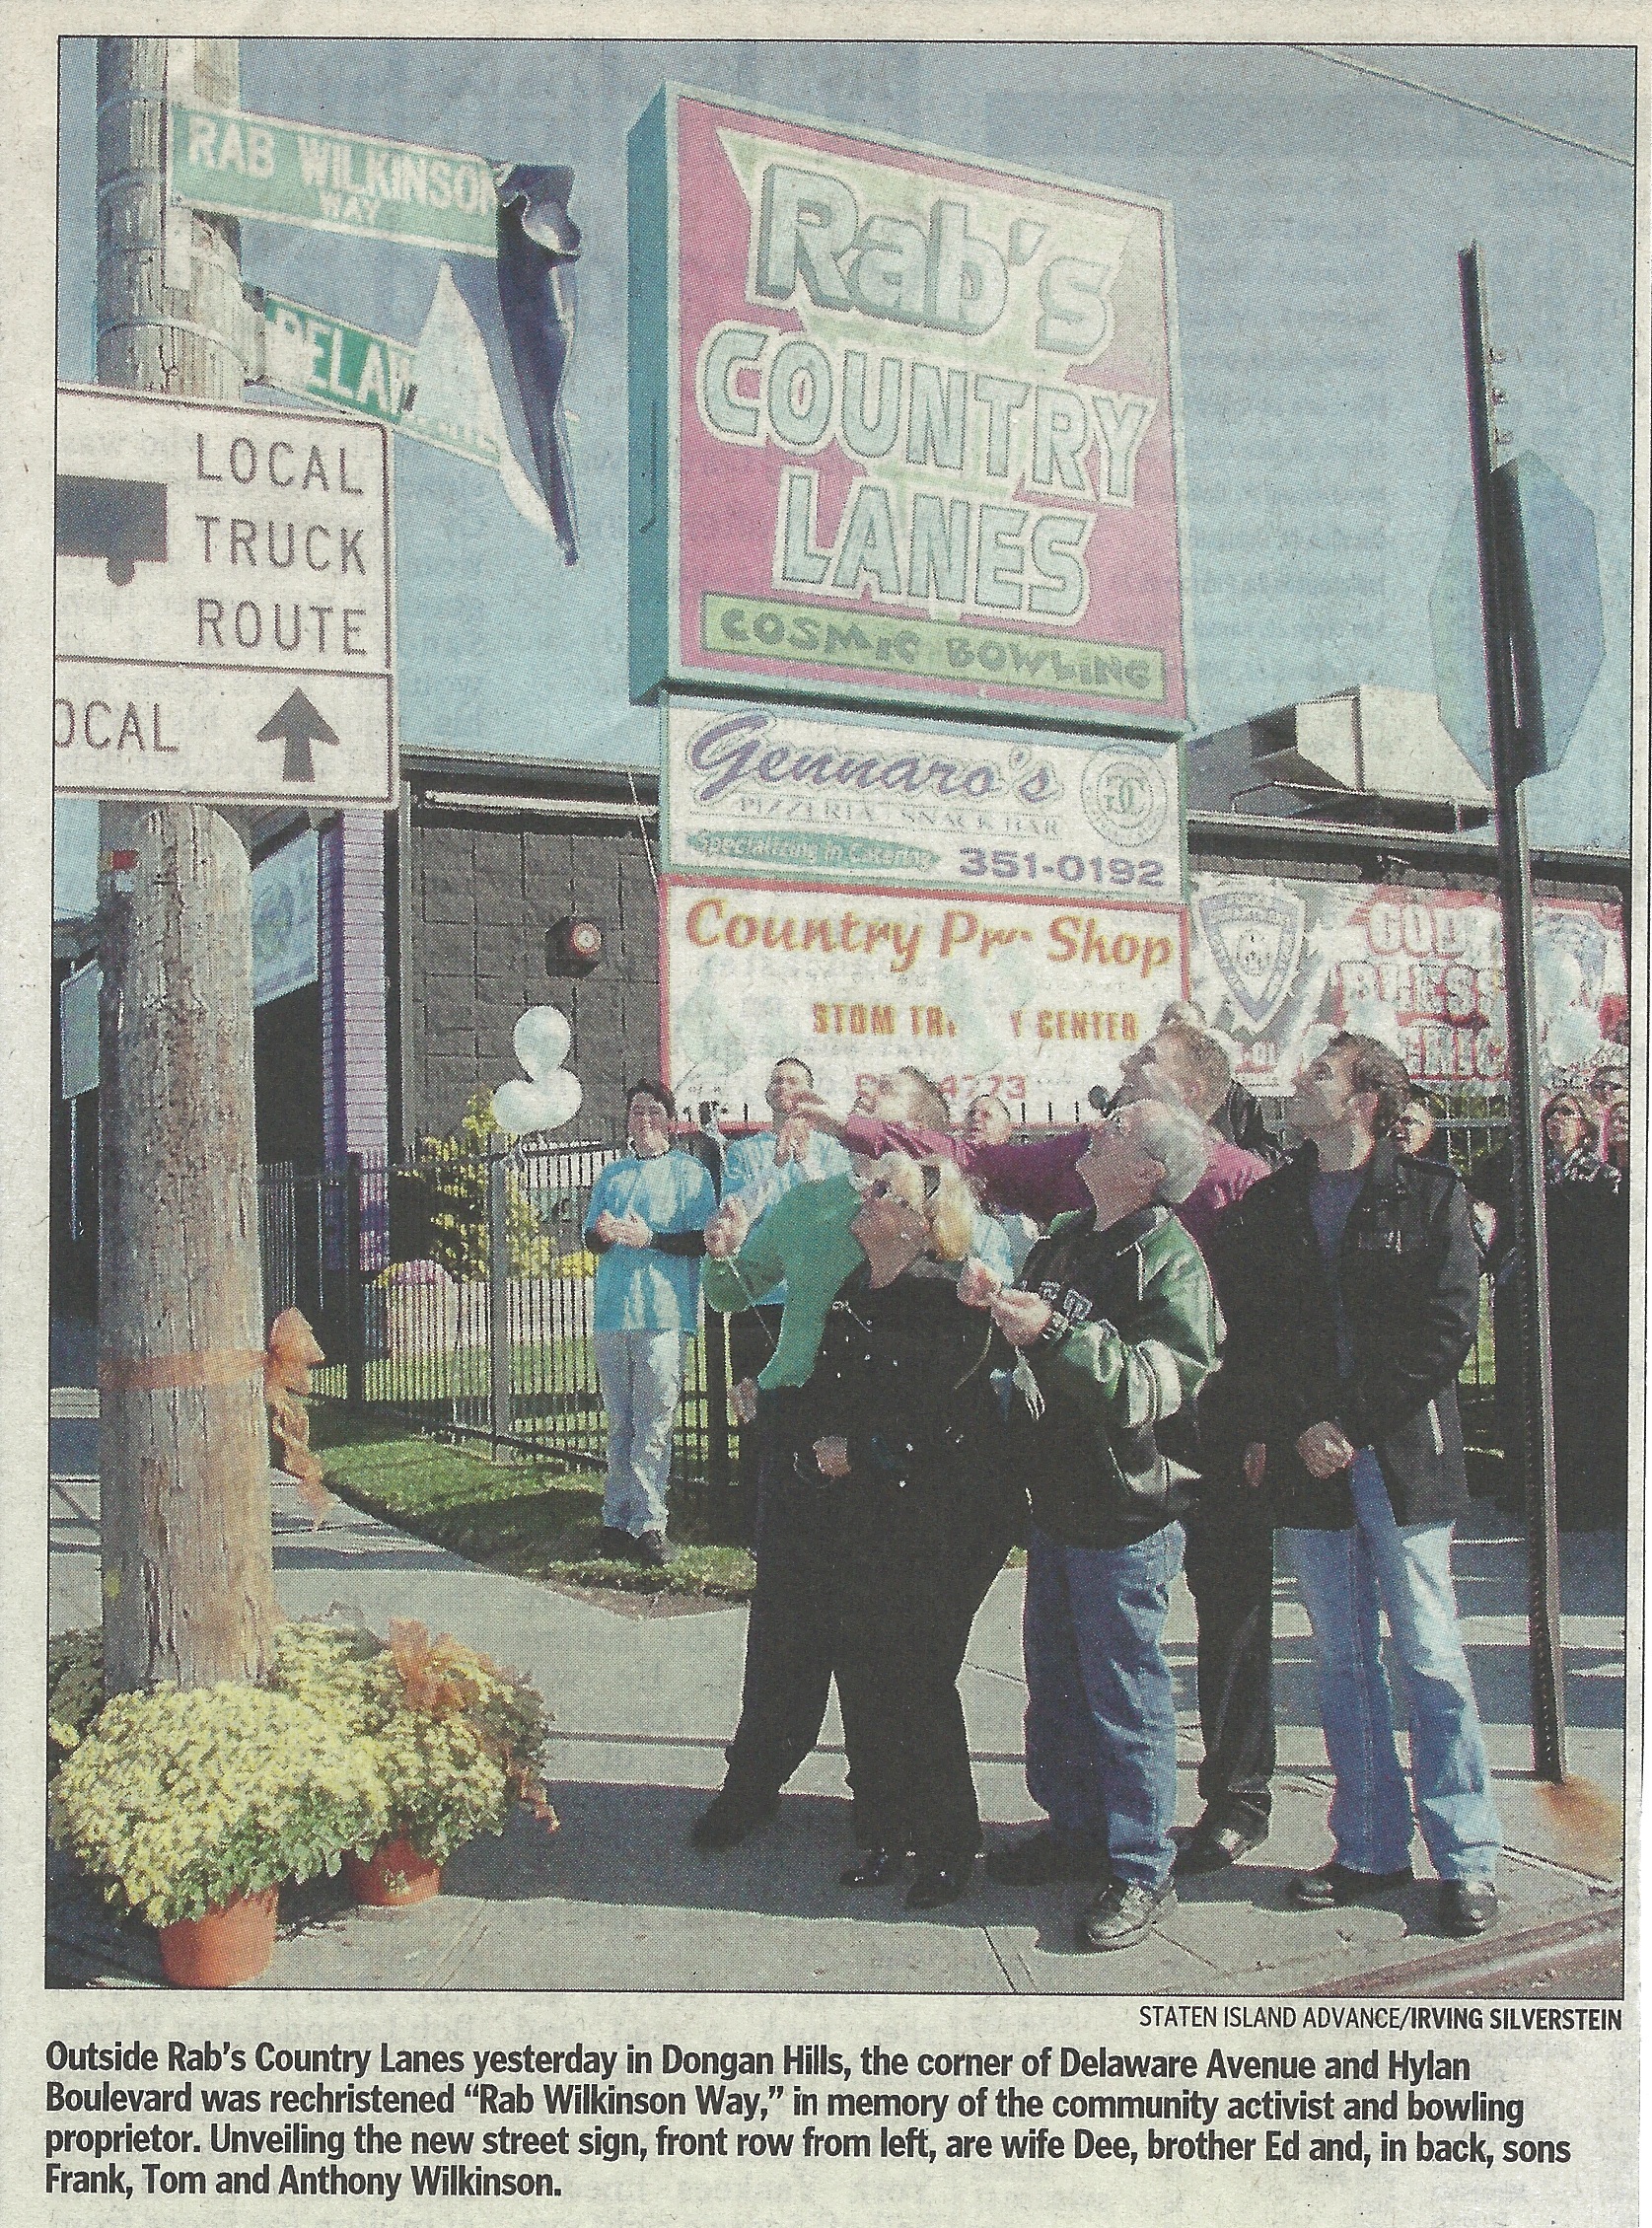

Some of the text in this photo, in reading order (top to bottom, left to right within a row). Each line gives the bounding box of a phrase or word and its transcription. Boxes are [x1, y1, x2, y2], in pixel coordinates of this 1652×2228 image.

[187, 115, 274, 180] RAB
[320, 192, 382, 226] WAY
[756, 163, 1115, 356] Rab's
[703, 327, 1155, 501] COUNTRY
[196, 433, 364, 495] LOCAL
[195, 514, 367, 575] TRUCK
[780, 468, 1090, 617] LANES
[197, 598, 368, 656] ROUTE
[54, 699, 180, 753] OCAL
[690, 714, 1050, 804] Gennaro's
[741, 797, 874, 822] PIZZERIA
[901, 809, 994, 831] SNACK
[695, 830, 818, 863] Specializing
[849, 843, 932, 872] Catering
[959, 847, 1164, 888] 351-0192
[685, 898, 923, 973] Country
[1046, 914, 1173, 978] Shop
[1367, 901, 1465, 957] GOD
[1038, 1009, 1139, 1042] CENTER
[1139, 2005, 1622, 2032] STATEN ISLAND ADVANCE/IRVING SILVERSTEIN
[45, 2040, 1471, 2087] Outside Rab's Country Lanes yesterday in Dongan Hills, the corner of Delaware Avenue and Hylan
[46, 2080, 1525, 2128] Boulevard was rechristened "Rab Wilkinson Way," in memory of the community activist and bowling
[45, 2121, 1571, 2170] proprietor. Unveiling the new street sign, front row from left, are wife Dee, brother Ed and, in back, sons
[45, 2162, 562, 2202] Frank, Tom and Anthony Wilkinson.
